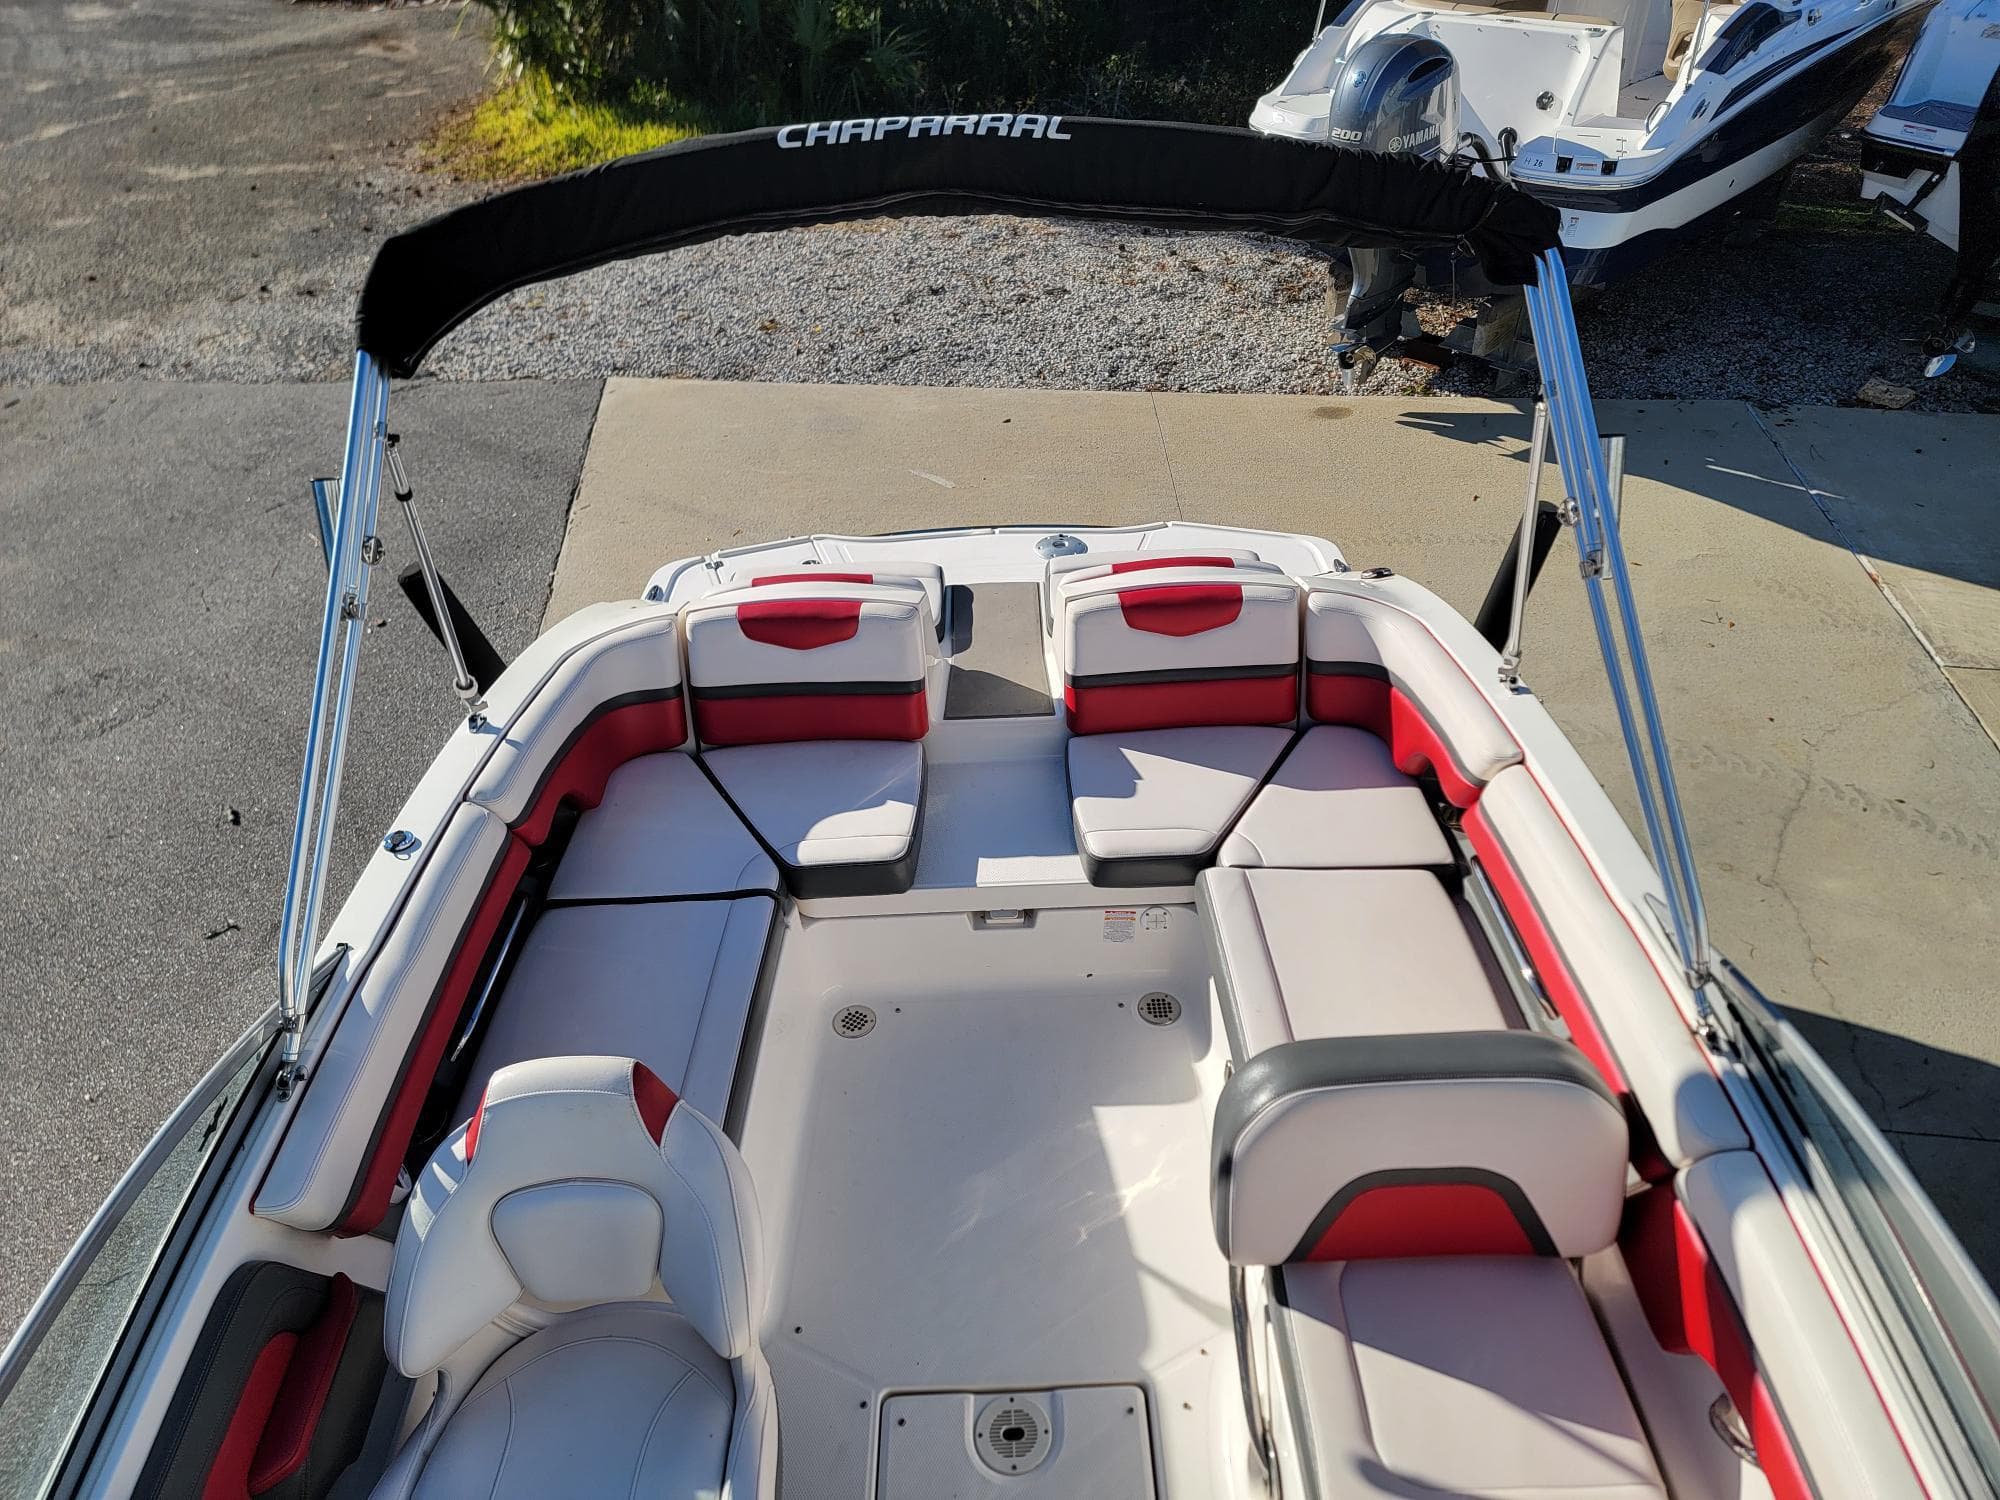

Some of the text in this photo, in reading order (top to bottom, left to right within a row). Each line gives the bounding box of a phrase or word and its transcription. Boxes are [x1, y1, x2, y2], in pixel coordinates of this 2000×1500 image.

[777, 113, 1072, 149] CHAPARRAL
[1331, 127, 1362, 143] 200
[1403, 123, 1440, 149] YAMAHA
